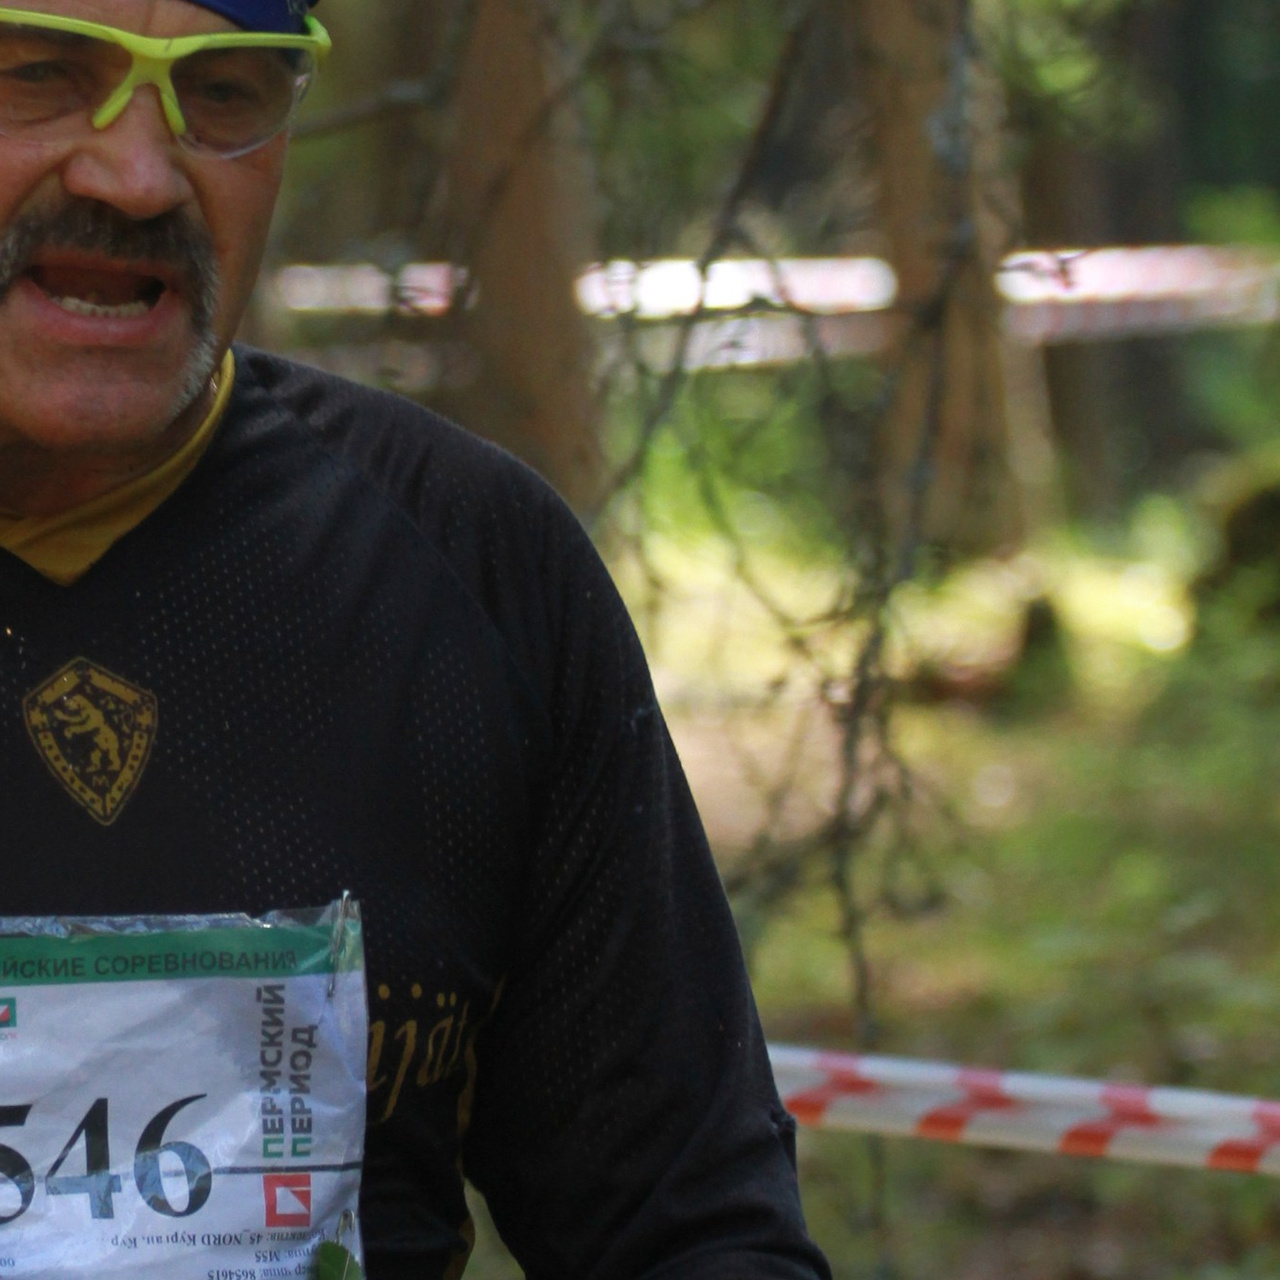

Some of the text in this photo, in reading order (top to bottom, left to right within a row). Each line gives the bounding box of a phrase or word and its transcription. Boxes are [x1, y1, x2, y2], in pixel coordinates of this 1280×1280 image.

[94, 949, 297, 974] СОРЕВНОВАНИЯ
[256, 984, 285, 1159] ПЕРМСКИЙ
[289, 1024, 318, 1158] ПЕРИОД
